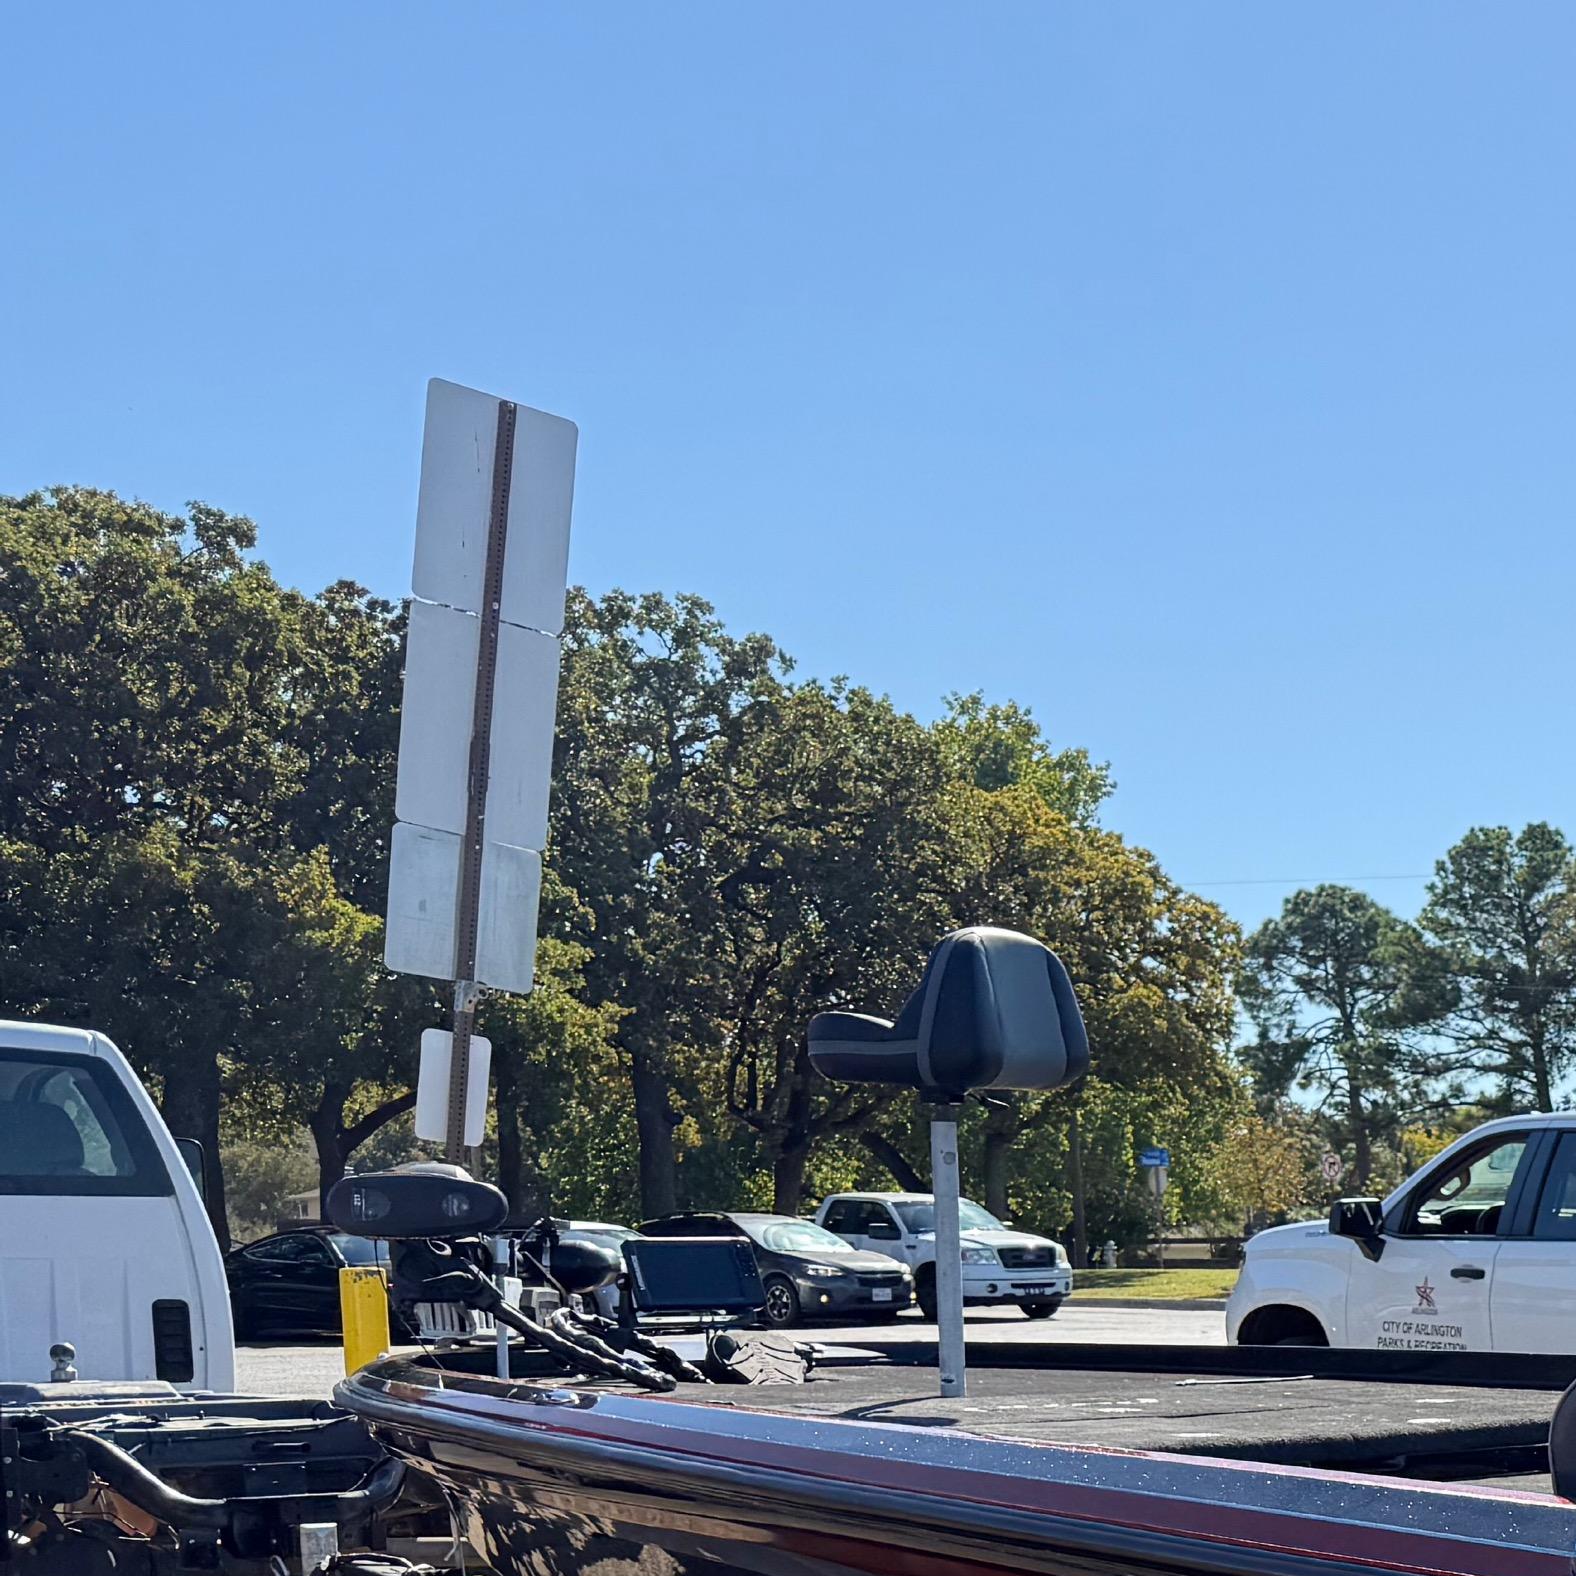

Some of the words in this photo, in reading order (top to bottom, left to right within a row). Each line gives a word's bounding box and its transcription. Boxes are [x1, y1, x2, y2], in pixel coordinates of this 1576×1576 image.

[1383, 1320, 1401, 1334] CITY
[1402, 1321, 1413, 1335] OF
[1414, 1323, 1463, 1338] ARLINGTON
